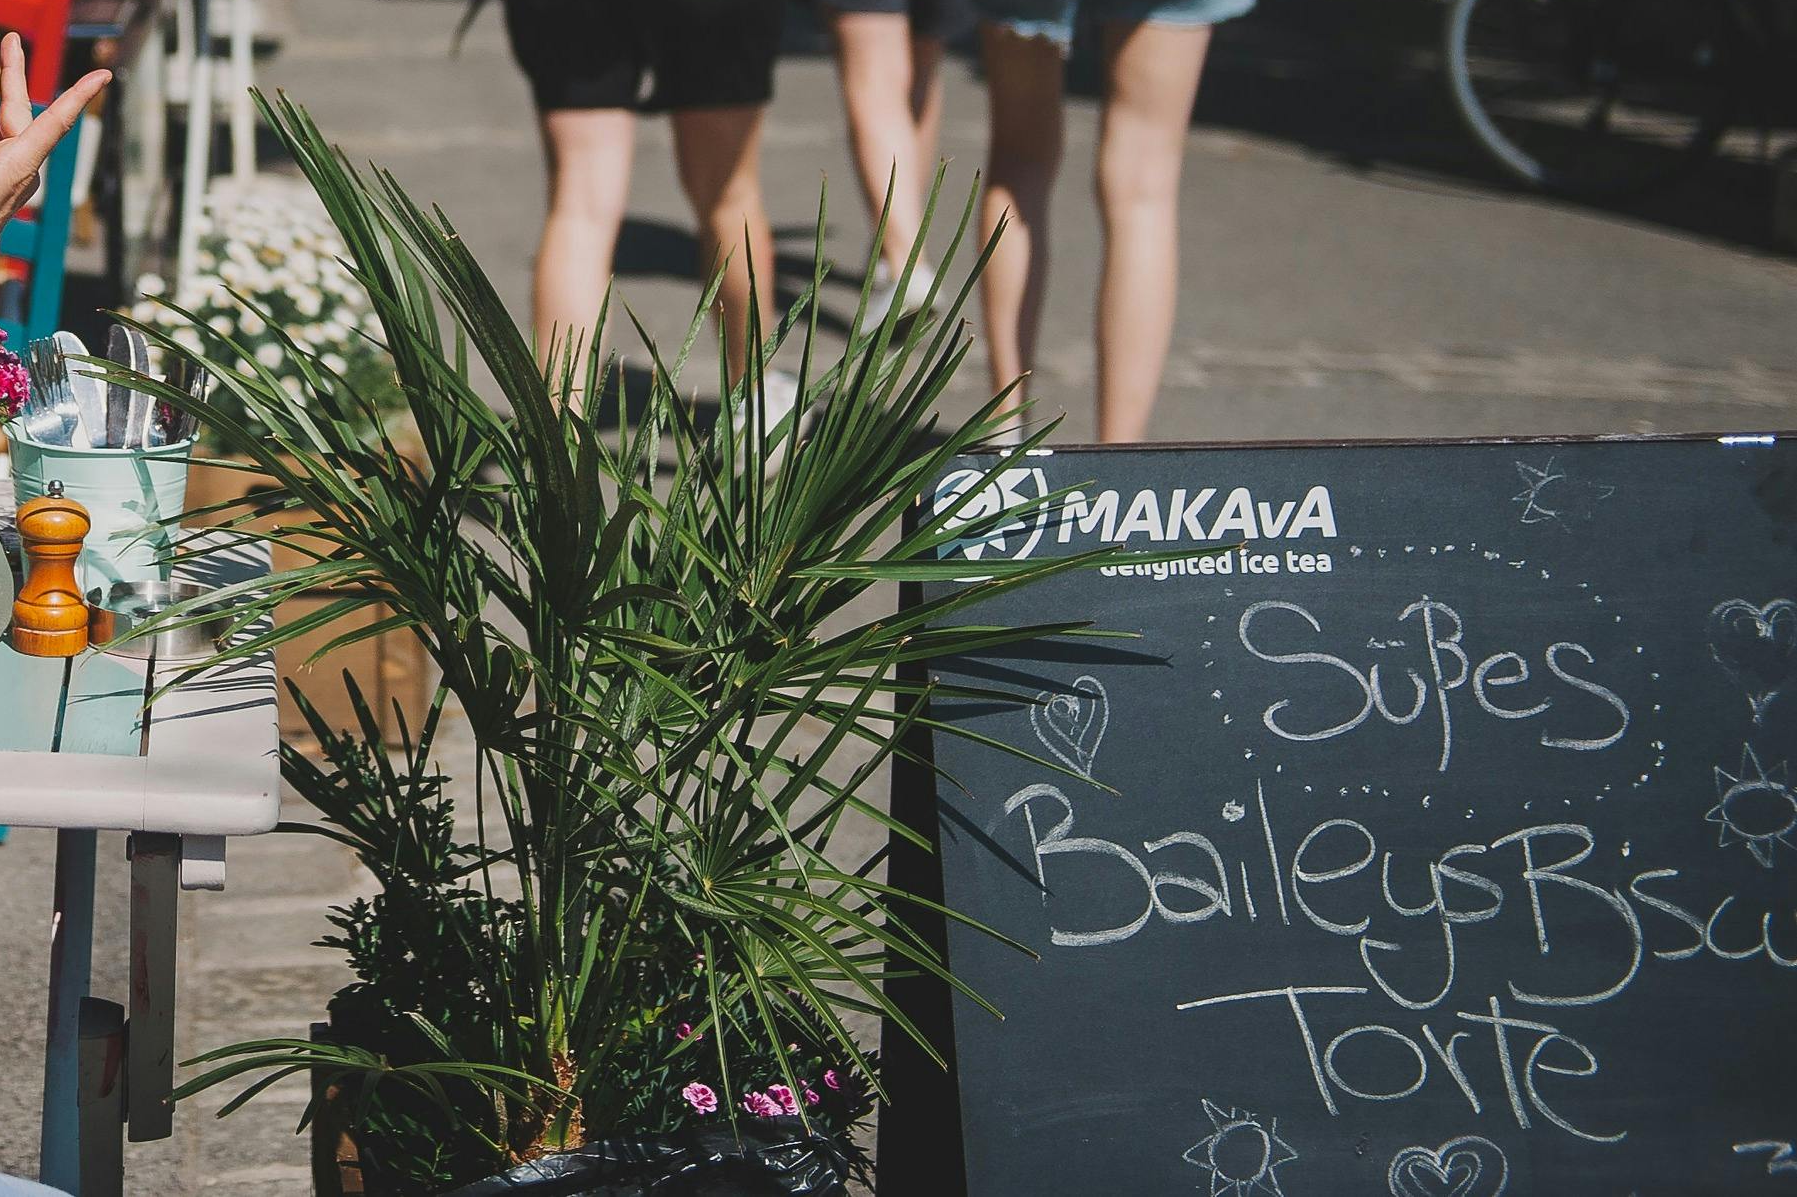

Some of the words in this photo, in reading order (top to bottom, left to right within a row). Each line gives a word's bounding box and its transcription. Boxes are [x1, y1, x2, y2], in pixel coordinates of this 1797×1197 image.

[1239, 548, 1280, 574] ice
[1285, 550, 1332, 573] tea
[1004, 778, 1504, 1010] Baileys
[1176, 982, 1628, 1142] Torte
